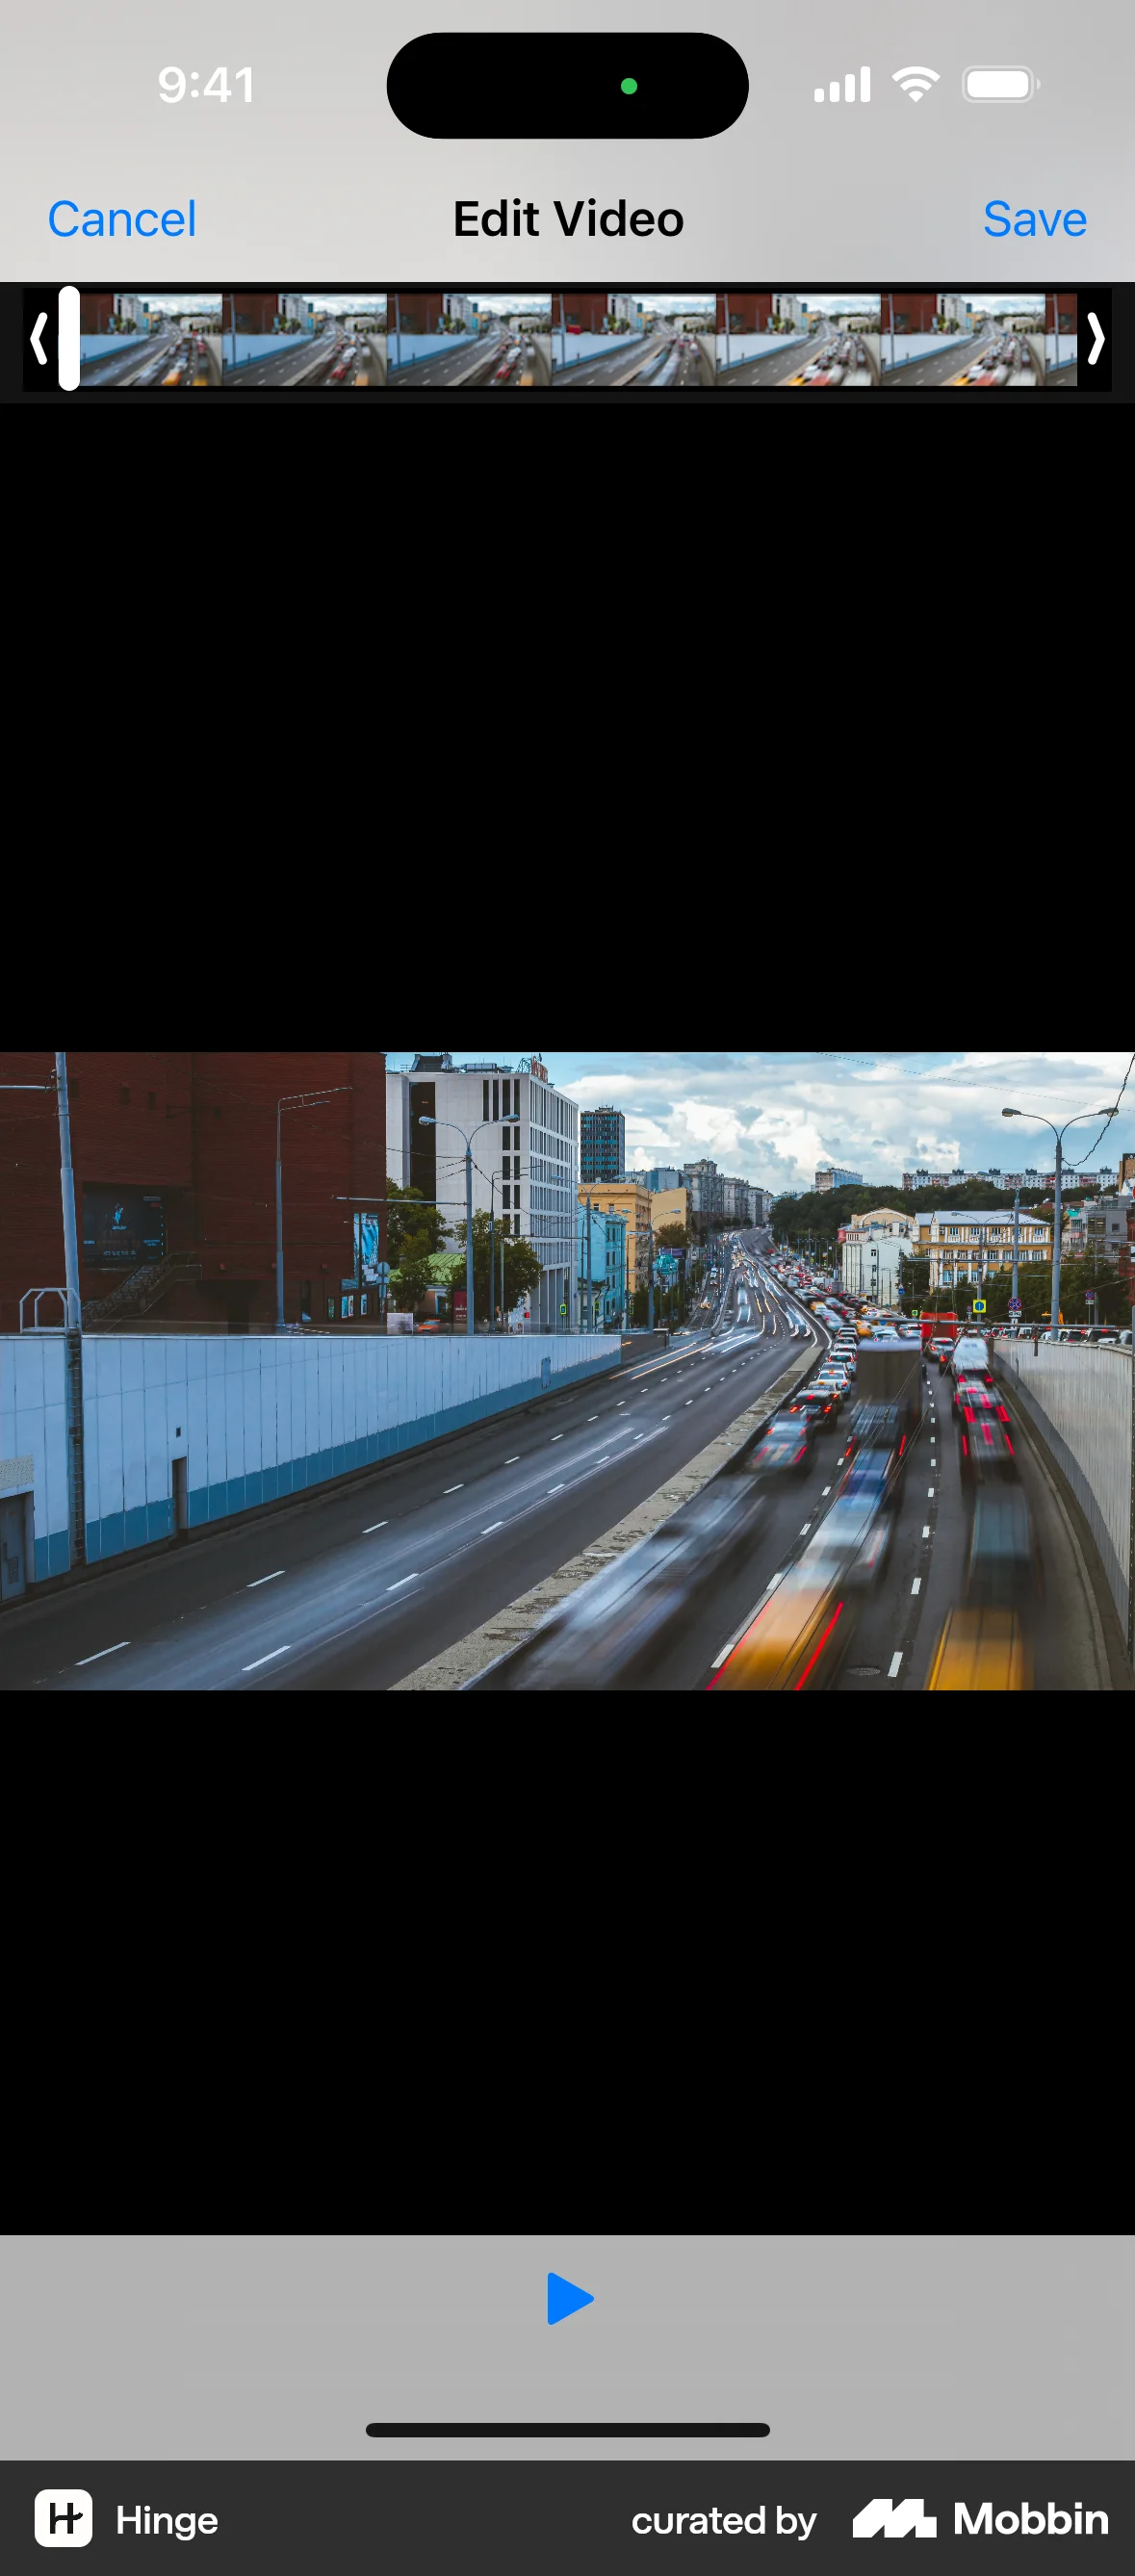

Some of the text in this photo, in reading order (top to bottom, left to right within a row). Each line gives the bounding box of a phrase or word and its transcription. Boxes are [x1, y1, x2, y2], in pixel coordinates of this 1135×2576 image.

[158, 65, 253, 104] 9:41
[48, 198, 196, 238] Cancel
[454, 198, 684, 238] Edit Video
[983, 199, 1088, 238] Save
